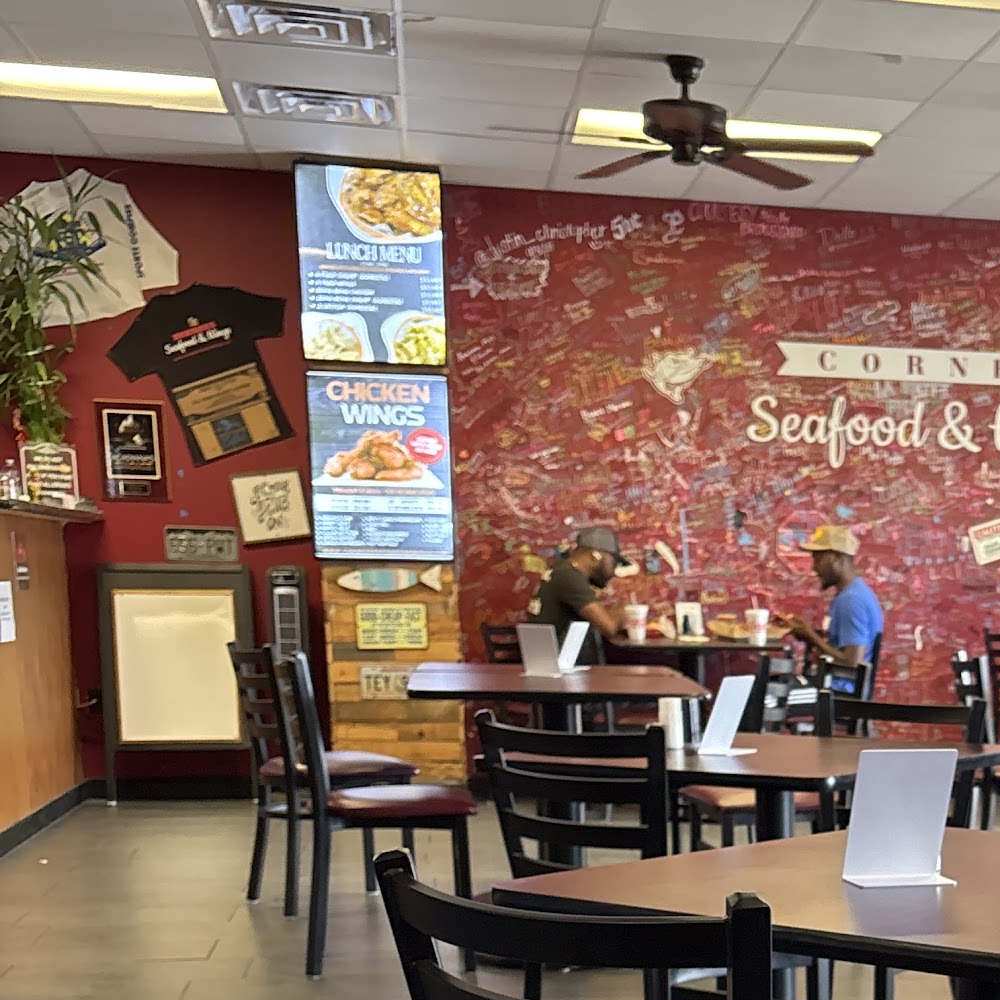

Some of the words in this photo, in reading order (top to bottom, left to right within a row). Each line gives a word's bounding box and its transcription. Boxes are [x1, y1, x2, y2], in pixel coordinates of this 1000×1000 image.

[325, 242, 377, 262] LUNCH
[379, 245, 422, 264] MENU
[326, 380, 431, 404] CHICKEN
[340, 403, 426, 427] WINGS
[746, 395, 931, 469] Seafood
[937, 400, 982, 453] &
